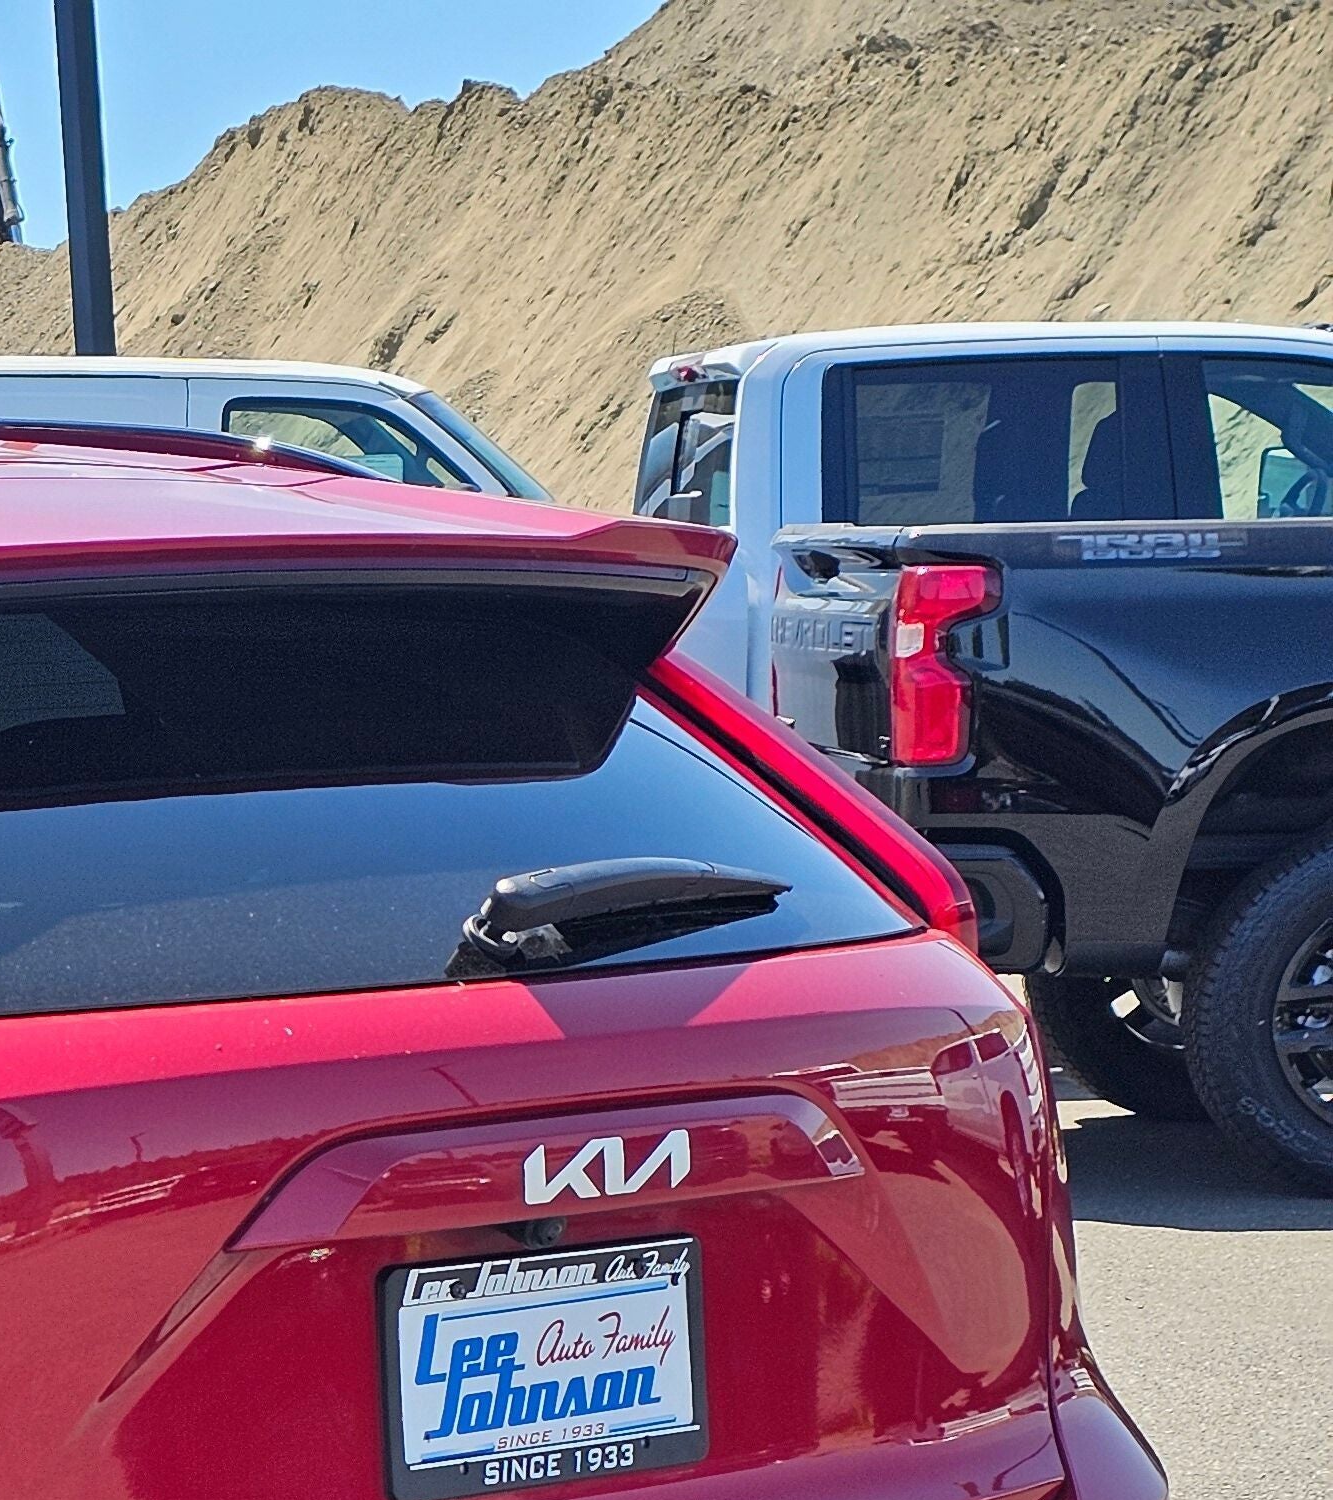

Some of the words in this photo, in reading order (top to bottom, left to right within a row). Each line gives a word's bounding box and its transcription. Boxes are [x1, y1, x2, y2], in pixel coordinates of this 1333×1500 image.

[523, 1128, 691, 1206] KIA
[465, 1258, 598, 1299] Johnson
[604, 1254, 639, 1282] Aut
[641, 1247, 691, 1282] Family
[414, 1313, 526, 1386] Lee
[536, 1319, 595, 1367] Auto
[597, 1305, 676, 1366] Family
[423, 1357, 662, 1441] Johnson
[483, 1452, 562, 1486] SINCE
[574, 1443, 634, 1473] 1933
[497, 1430, 553, 1450] SINCE
[562, 1422, 606, 1441] 1933
